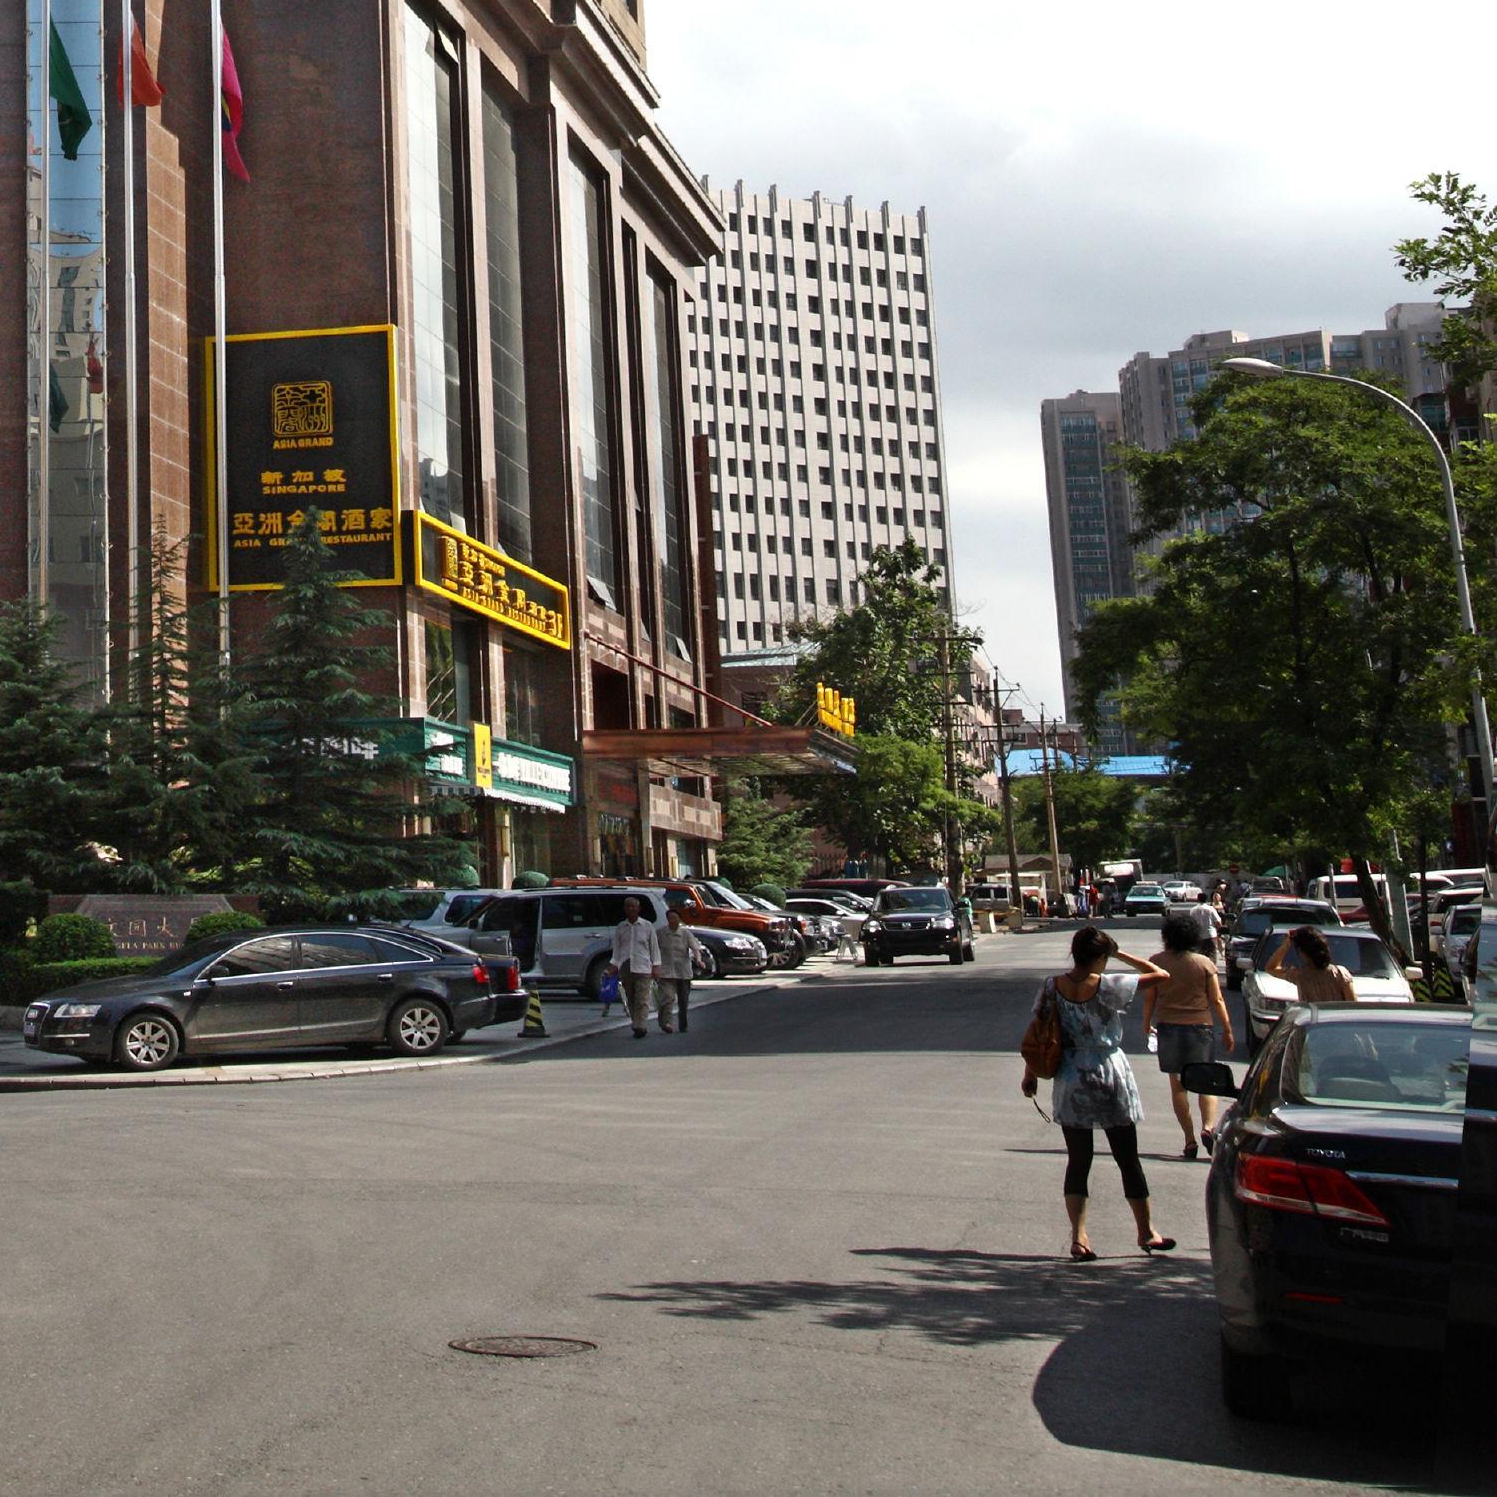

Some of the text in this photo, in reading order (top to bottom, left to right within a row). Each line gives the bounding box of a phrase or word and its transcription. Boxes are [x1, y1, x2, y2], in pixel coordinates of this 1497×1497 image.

[261, 469, 346, 484] 新加坡
[262, 484, 345, 495] SINGAPORE
[233, 538, 262, 548] ASIA
[1307, 1149, 1345, 1158] TOYOTA
